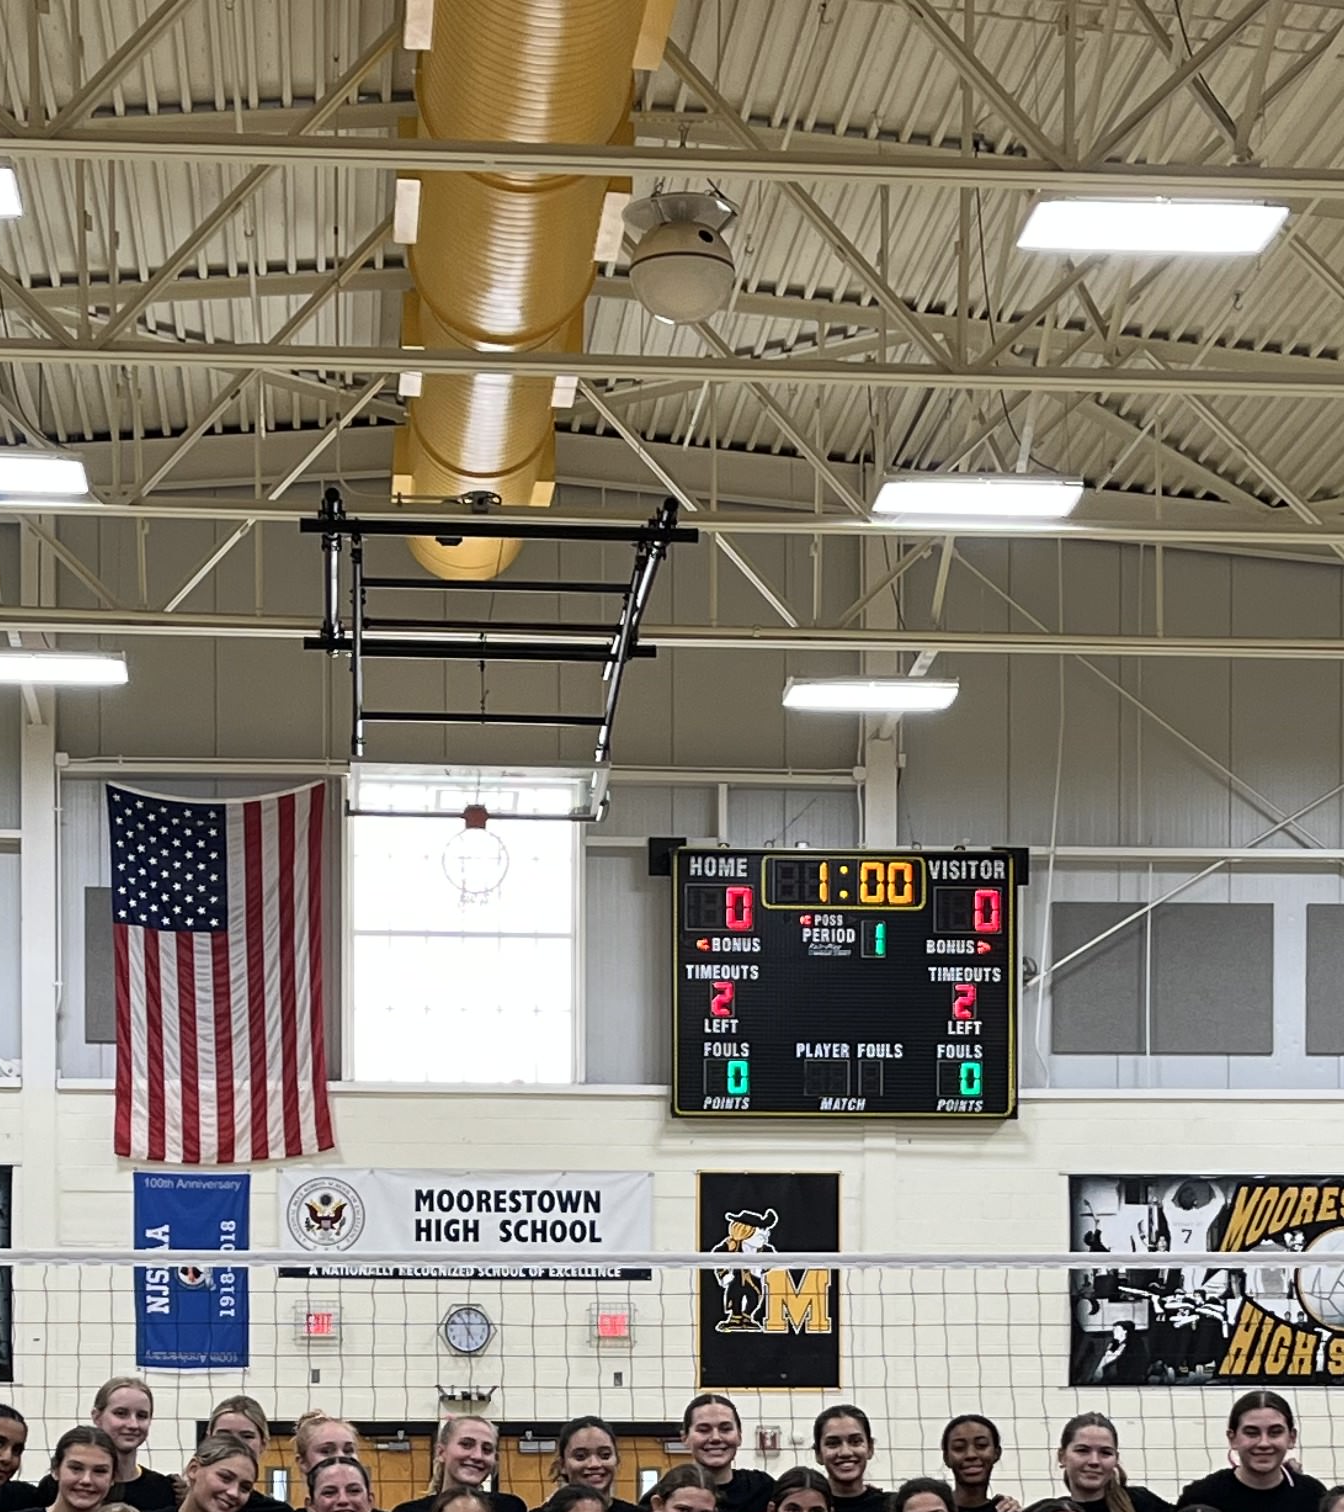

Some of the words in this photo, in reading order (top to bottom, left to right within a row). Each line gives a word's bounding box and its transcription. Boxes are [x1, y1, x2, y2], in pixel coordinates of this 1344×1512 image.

[689, 856, 748, 878] HOME
[928, 859, 1007, 881] VISITOR
[819, 860, 913, 904] 1:00
[725, 885, 754, 932] 0
[973, 887, 1002, 934] 0
[814, 914, 844, 926] POSS
[802, 928, 856, 943] PERIOD
[711, 937, 762, 953] BONUS
[926, 939, 975, 955] BONUS
[685, 964, 760, 980] TIMEOUTS
[927, 967, 1002, 983] TIMEOUTS
[710, 981, 736, 1017] 2
[953, 983, 977, 1019] 2
[704, 1019, 739, 1034] LEFT
[947, 1020, 982, 1036] LEFT
[703, 1042, 750, 1058] FOULS
[795, 1043, 850, 1058] PLAYER
[857, 1043, 904, 1058] FOULS
[937, 1044, 983, 1059] FOULS
[726, 1059, 750, 1095] 0
[958, 1061, 982, 1097] 0
[703, 1096, 751, 1110] POINTS
[820, 1097, 866, 1111] MATCH
[937, 1098, 984, 1112] POINTS
[144, 1176, 175, 1190] 100th
[175, 1177, 241, 1192] Anniversary
[414, 1188, 602, 1214] MOORESTOWN
[414, 1218, 481, 1243] HIGH
[499, 1218, 603, 1244] SCHOOL
[145, 1224, 170, 1315] NJSA
[308, 1267, 318, 1277] A
[321, 1267, 396, 1277] NATIONALLY
[399, 1267, 474, 1278] RECOGNIZED
[478, 1267, 527, 1278] SCHOOL
[529, 1268, 544, 1278] OF
[548, 1268, 622, 1278] EXCELLENCE
[1218, 1299, 1314, 1376] HIGH
